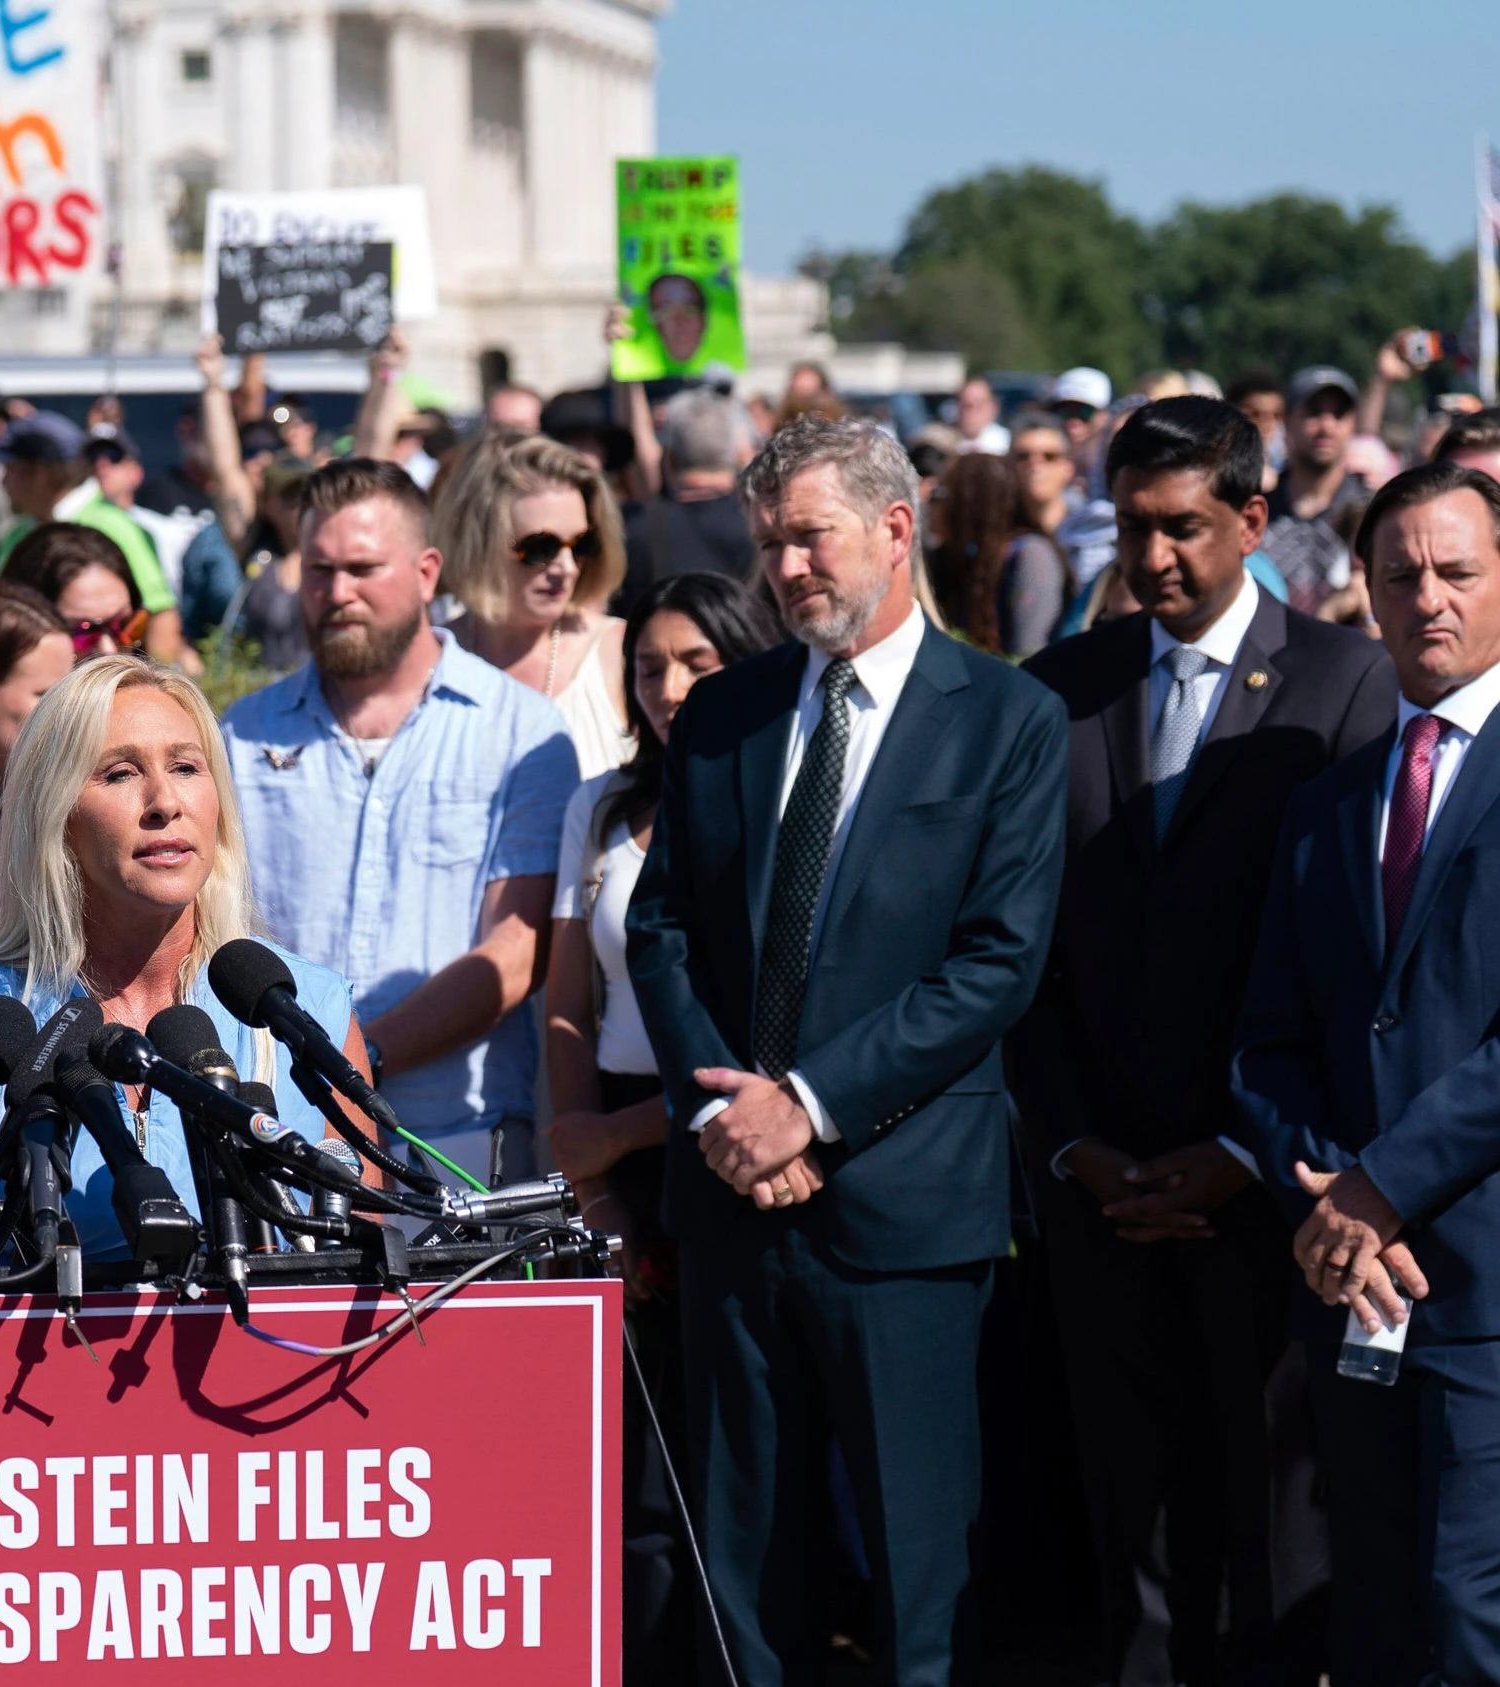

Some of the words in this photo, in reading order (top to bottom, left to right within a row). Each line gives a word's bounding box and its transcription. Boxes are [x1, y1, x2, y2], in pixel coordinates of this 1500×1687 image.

[622, 233, 722, 268] FILES
[31, 1021, 69, 1072] SENNHEISER
[238, 1447, 430, 1541] FILES
[410, 1559, 551, 1650] ACT
